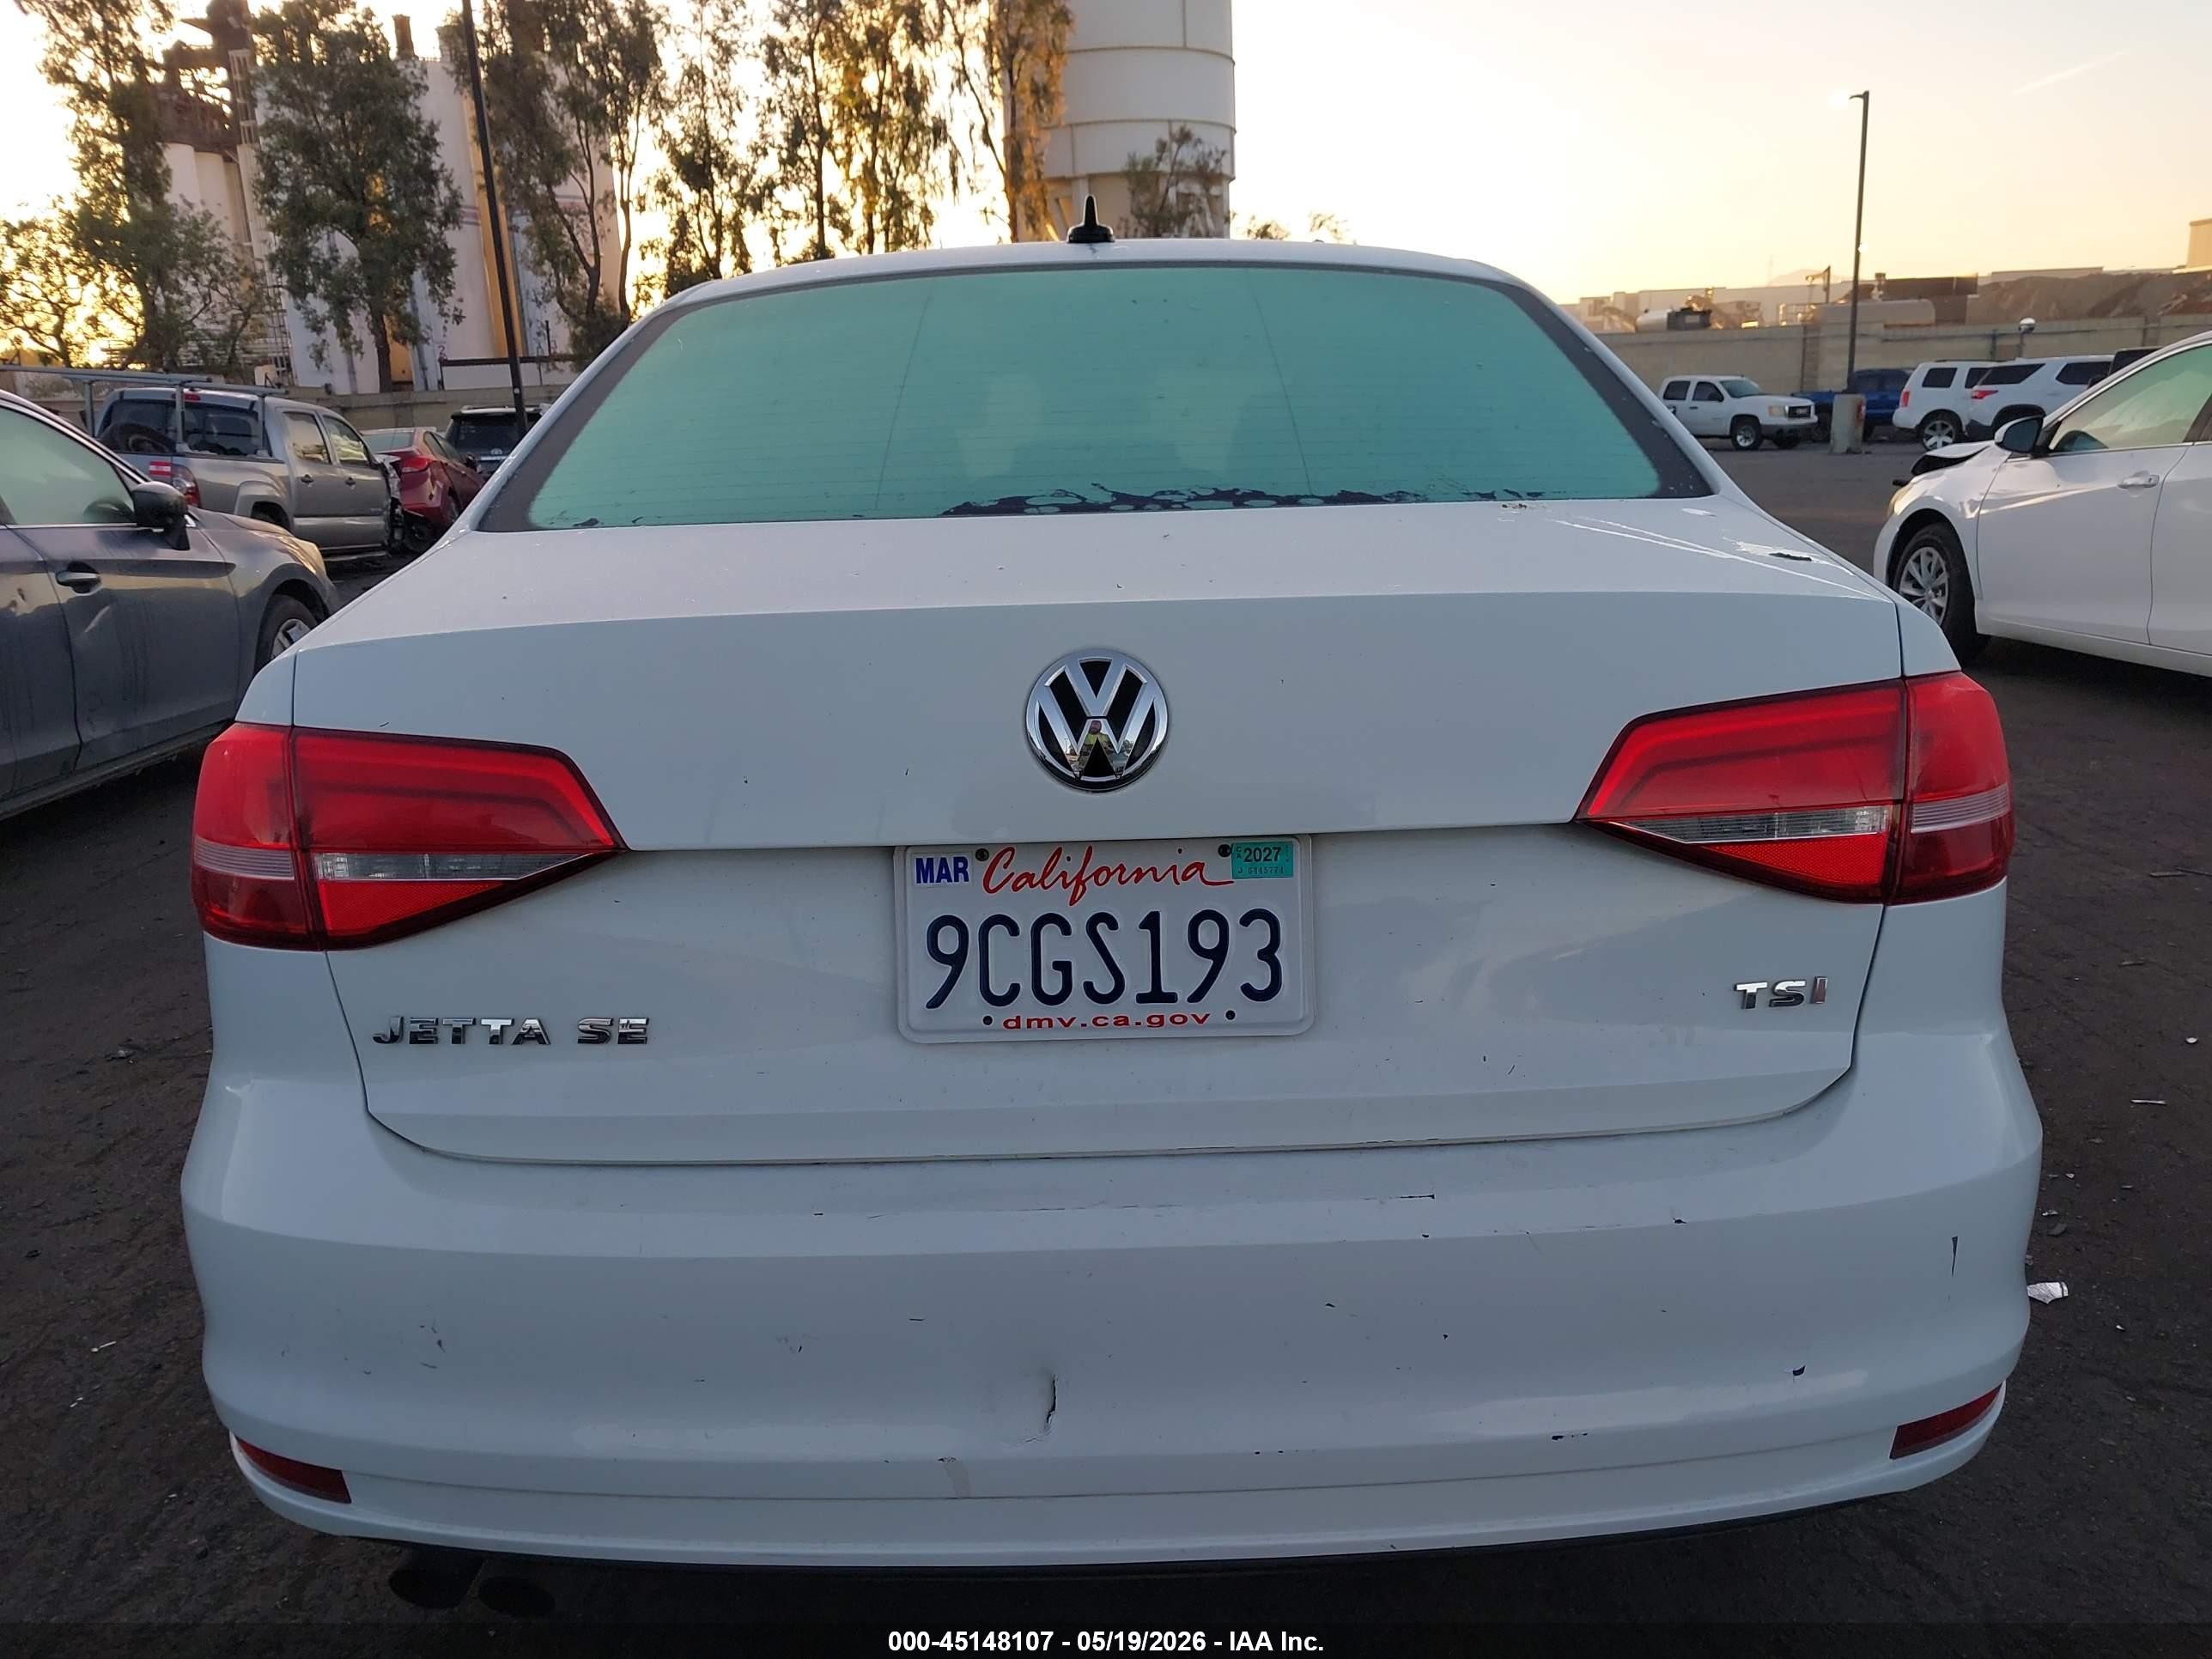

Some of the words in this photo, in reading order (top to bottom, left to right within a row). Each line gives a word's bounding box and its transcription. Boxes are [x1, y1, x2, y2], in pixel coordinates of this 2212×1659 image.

[1243, 847, 1282, 862] 2027
[915, 856, 969, 884] MAR
[982, 846, 1235, 907] California
[925, 908, 1283, 1010] 9CGS193
[1734, 976, 1828, 1009] TSI
[371, 1016, 551, 1045] JETTA
[576, 1017, 650, 1045] SE
[1002, 1011, 1212, 1030] dmv.ca.gov
